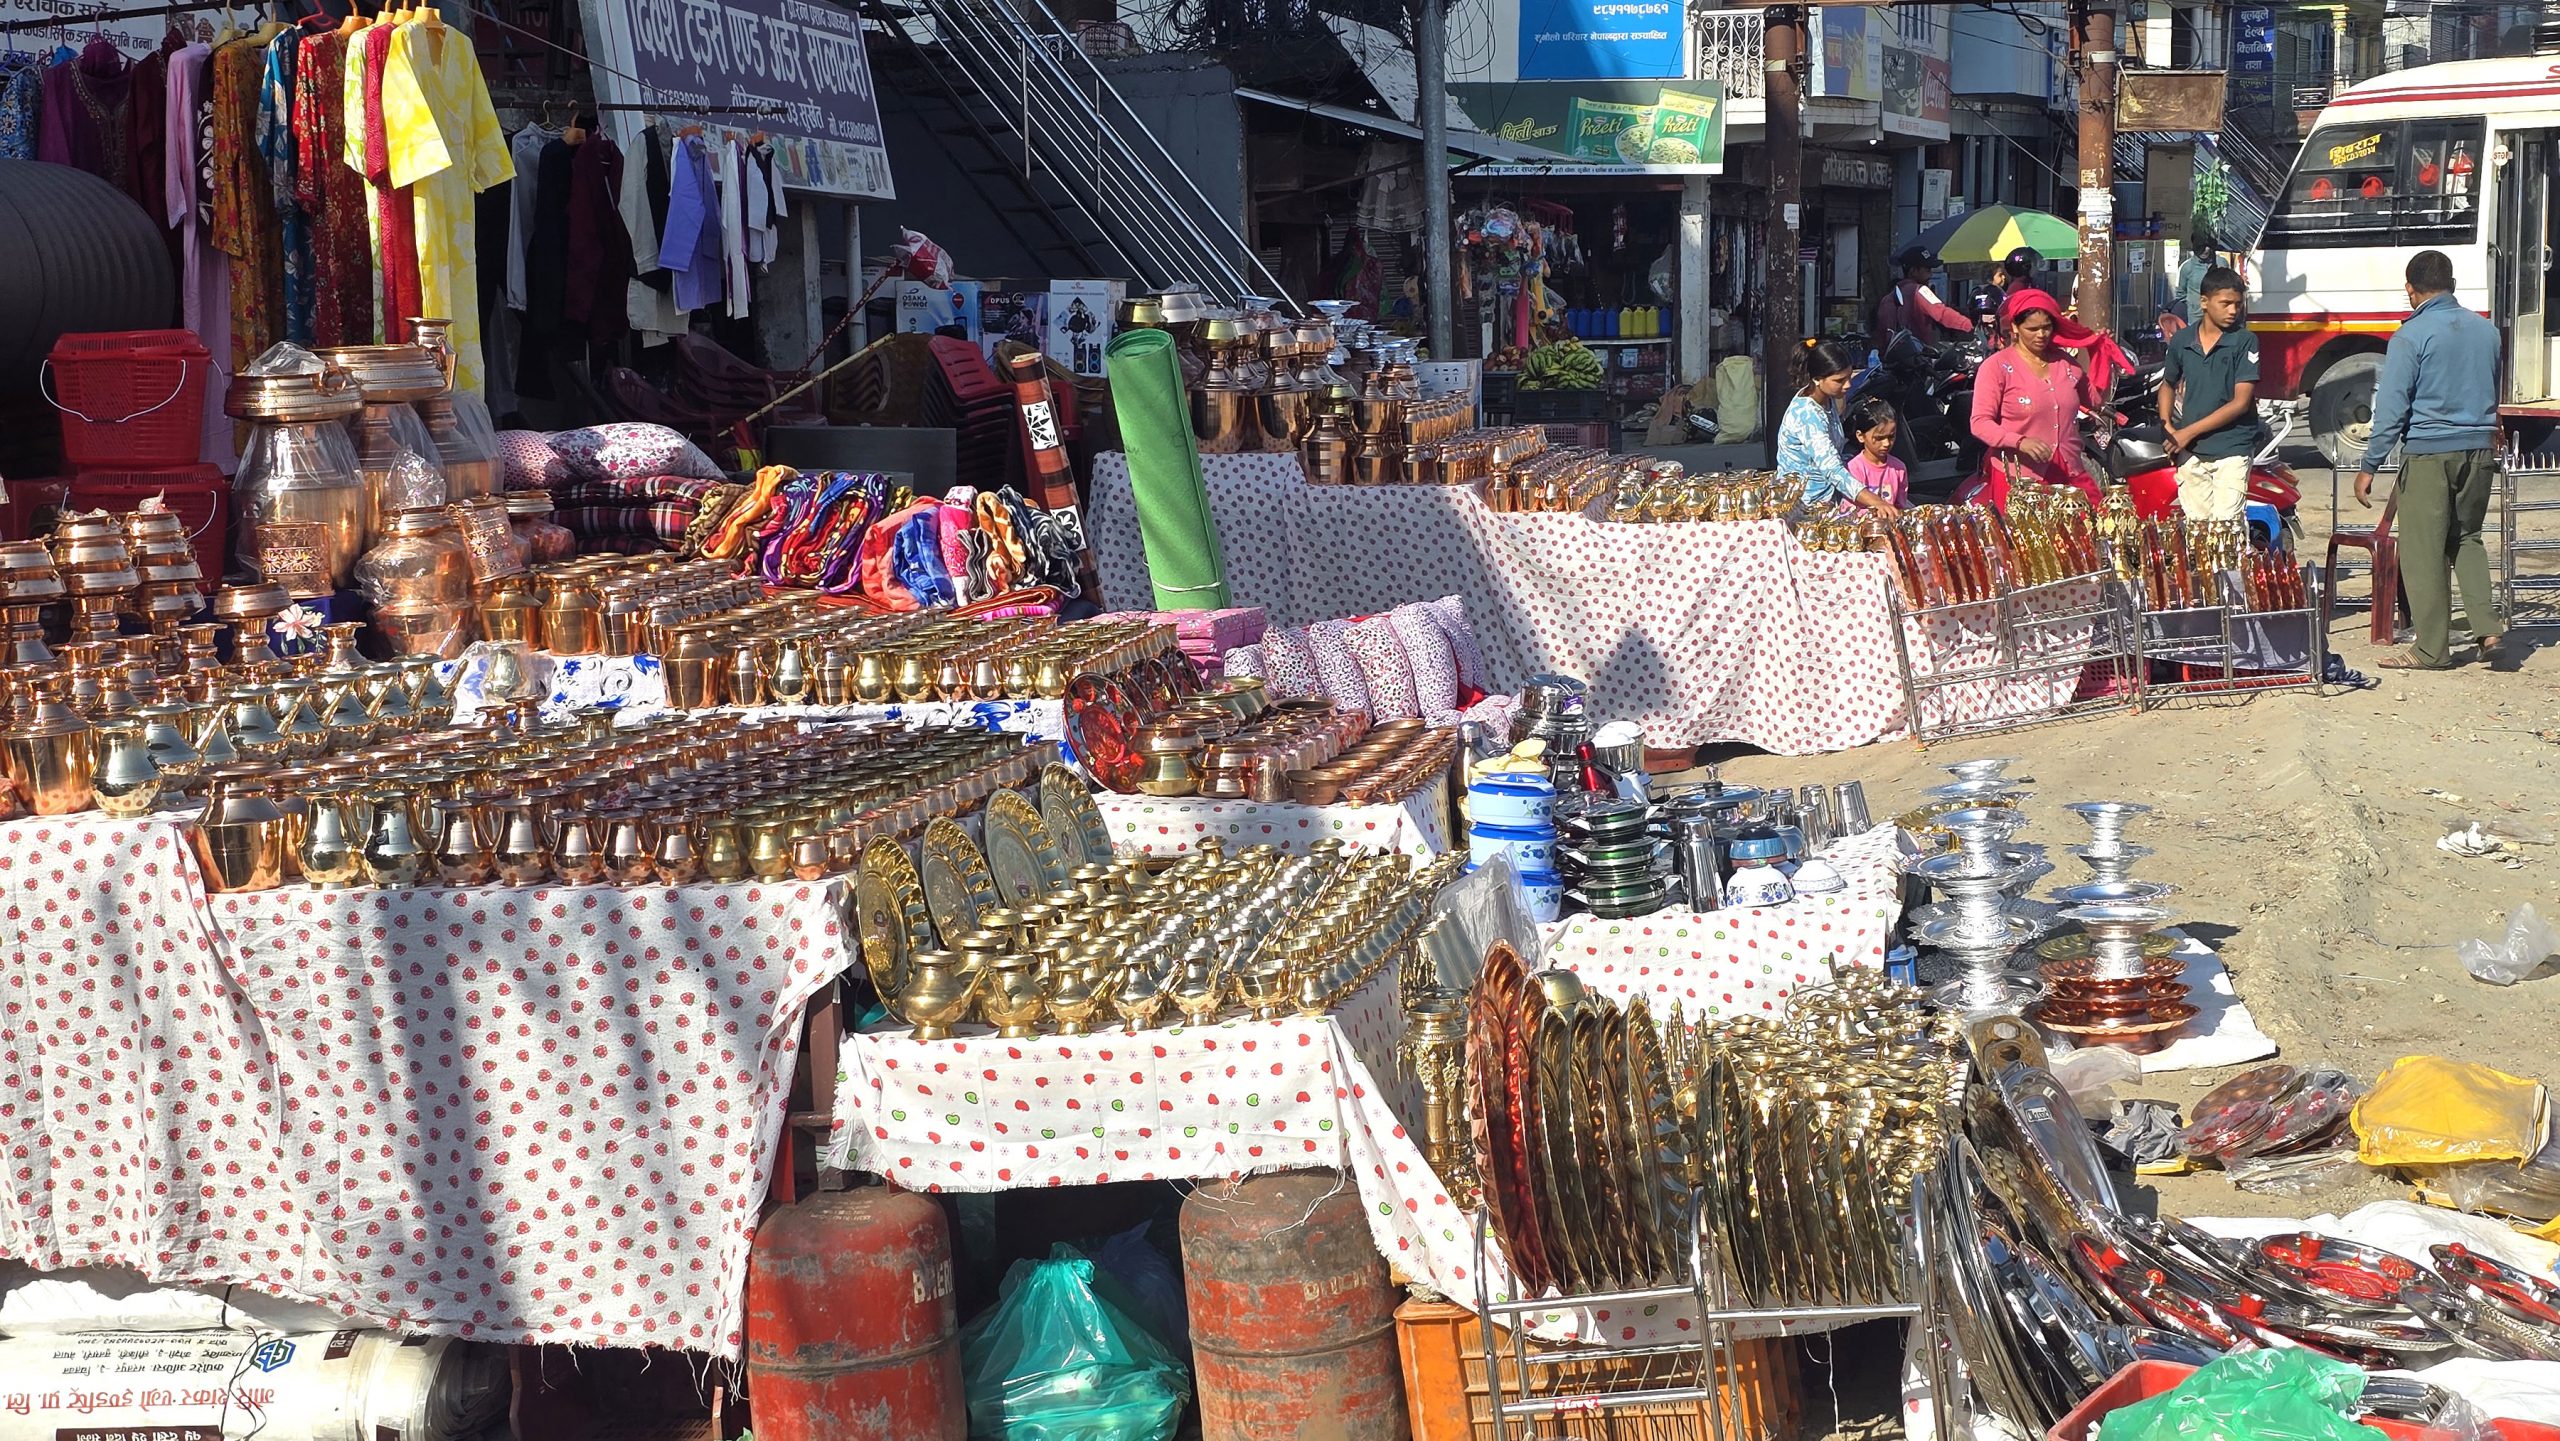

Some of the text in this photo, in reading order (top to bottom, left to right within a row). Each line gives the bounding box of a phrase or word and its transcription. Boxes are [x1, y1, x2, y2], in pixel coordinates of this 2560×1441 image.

[1662, 115, 1698, 134] Preeti
[53, 1350, 76, 1359] नेपाल
[62, 1364, 91, 1374] चितवन
[115, 1363, 146, 1373] भरतपुर
